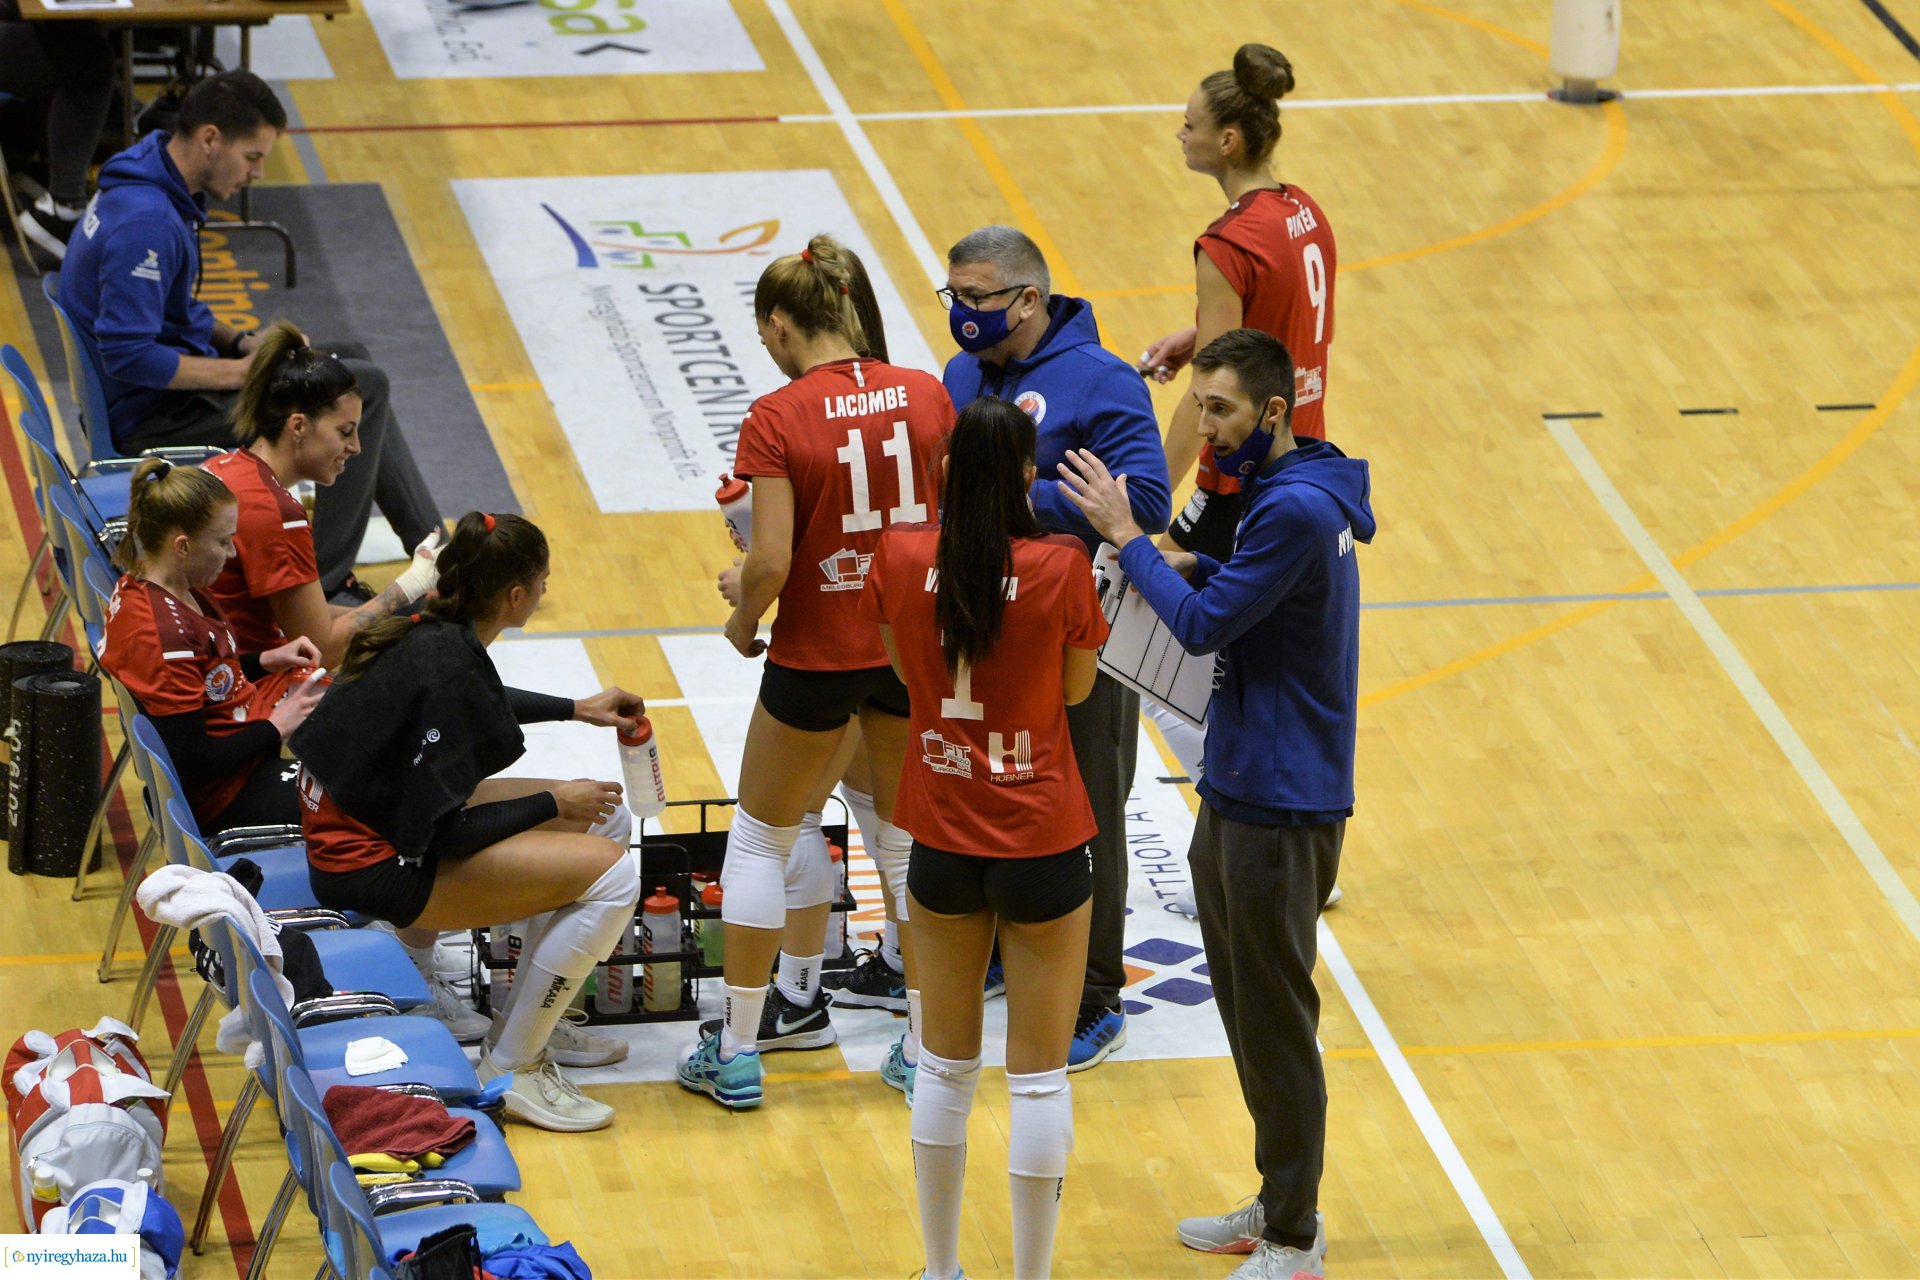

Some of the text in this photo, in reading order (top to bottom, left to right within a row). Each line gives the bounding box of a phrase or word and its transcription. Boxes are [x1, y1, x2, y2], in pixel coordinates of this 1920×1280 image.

[1303, 242, 1327, 344] 9
[825, 385, 908, 419] LACOMBE
[837, 420, 928, 533] 11
[944, 741, 971, 759] FIT
[541, 974, 568, 1009] MIKASA
